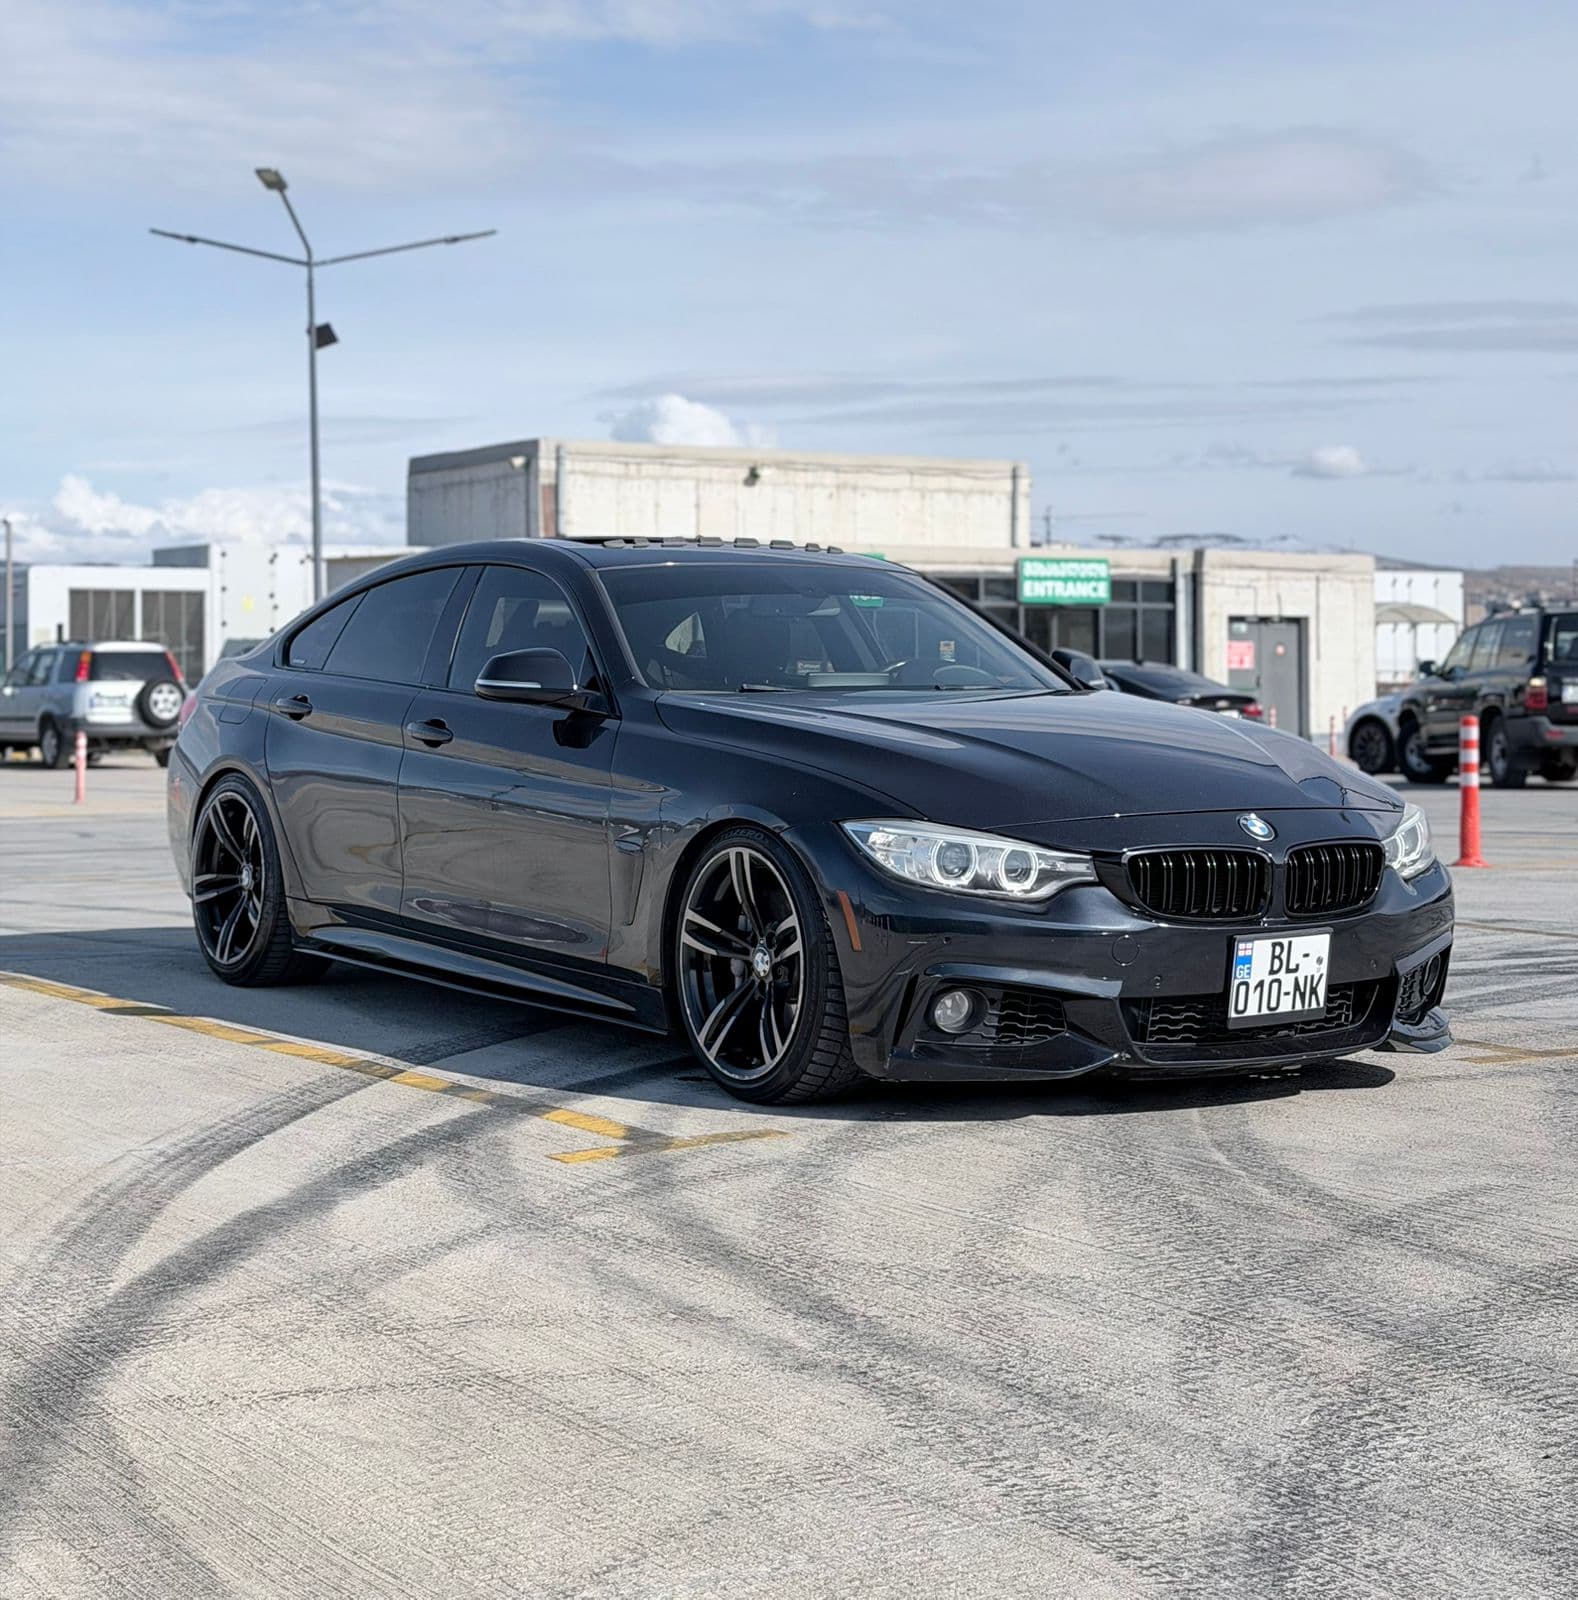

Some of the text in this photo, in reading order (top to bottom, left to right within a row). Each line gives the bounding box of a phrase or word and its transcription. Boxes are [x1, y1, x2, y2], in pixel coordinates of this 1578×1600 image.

[1023, 580, 1109, 598] ENTRANCE
[1236, 964, 1251, 979] GE
[1268, 940, 1310, 976] BL-
[1233, 973, 1324, 1015] 010-NK
